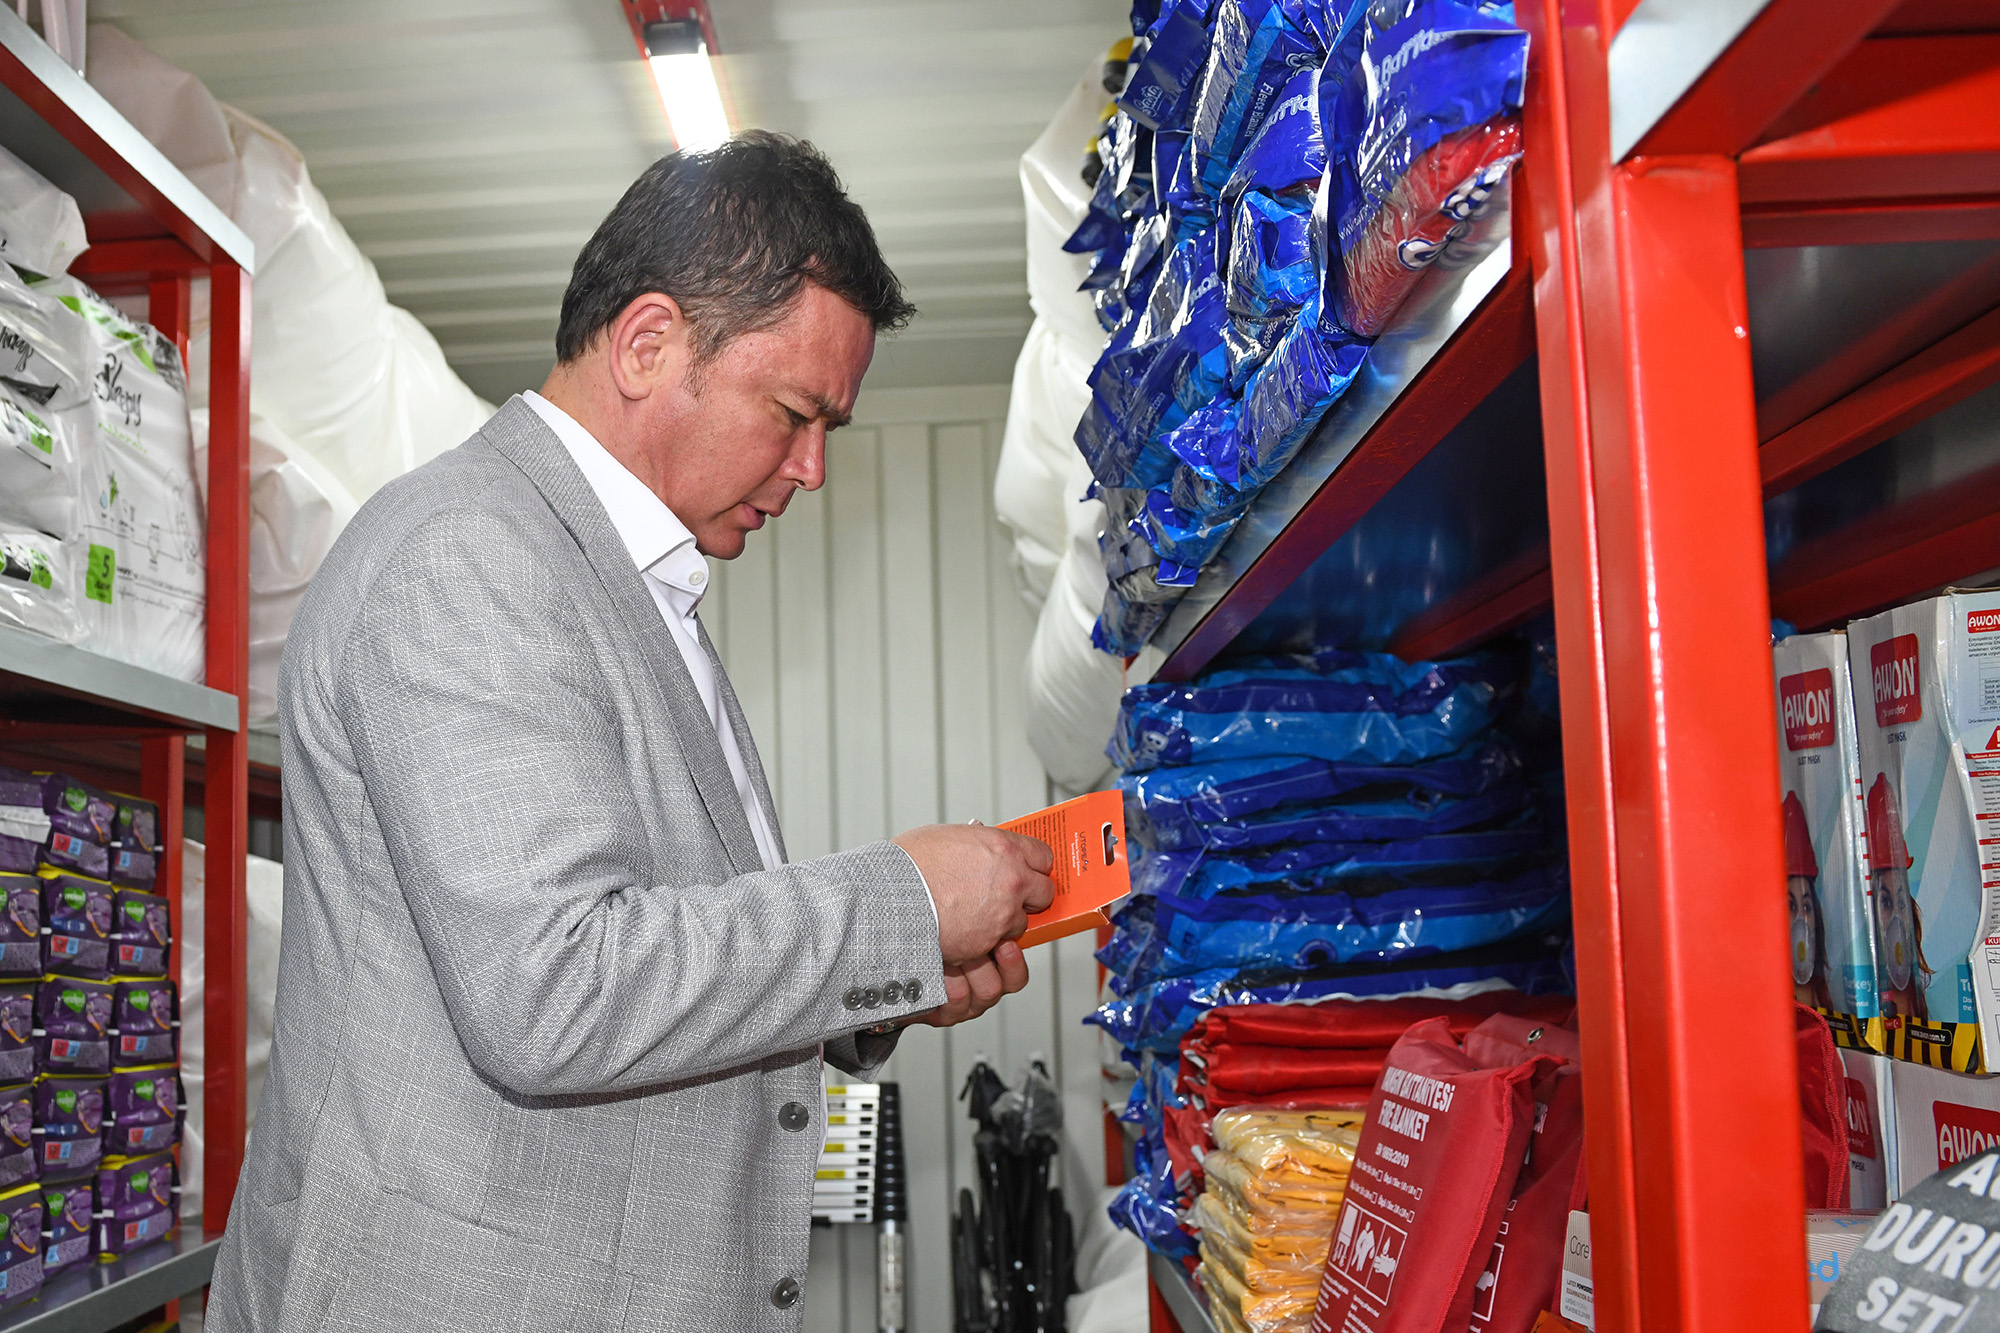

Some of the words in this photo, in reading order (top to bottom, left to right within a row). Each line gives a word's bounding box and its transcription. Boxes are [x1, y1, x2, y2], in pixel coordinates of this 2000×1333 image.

[1252, 82, 1274, 111] Fleece
[1874, 656, 1915, 704] AWON
[1784, 688, 1832, 730] AWON
[1847, 1096, 1869, 1135] ON
[1570, 1235, 1590, 1259] Core
[1863, 1202, 2000, 1290] DURU
